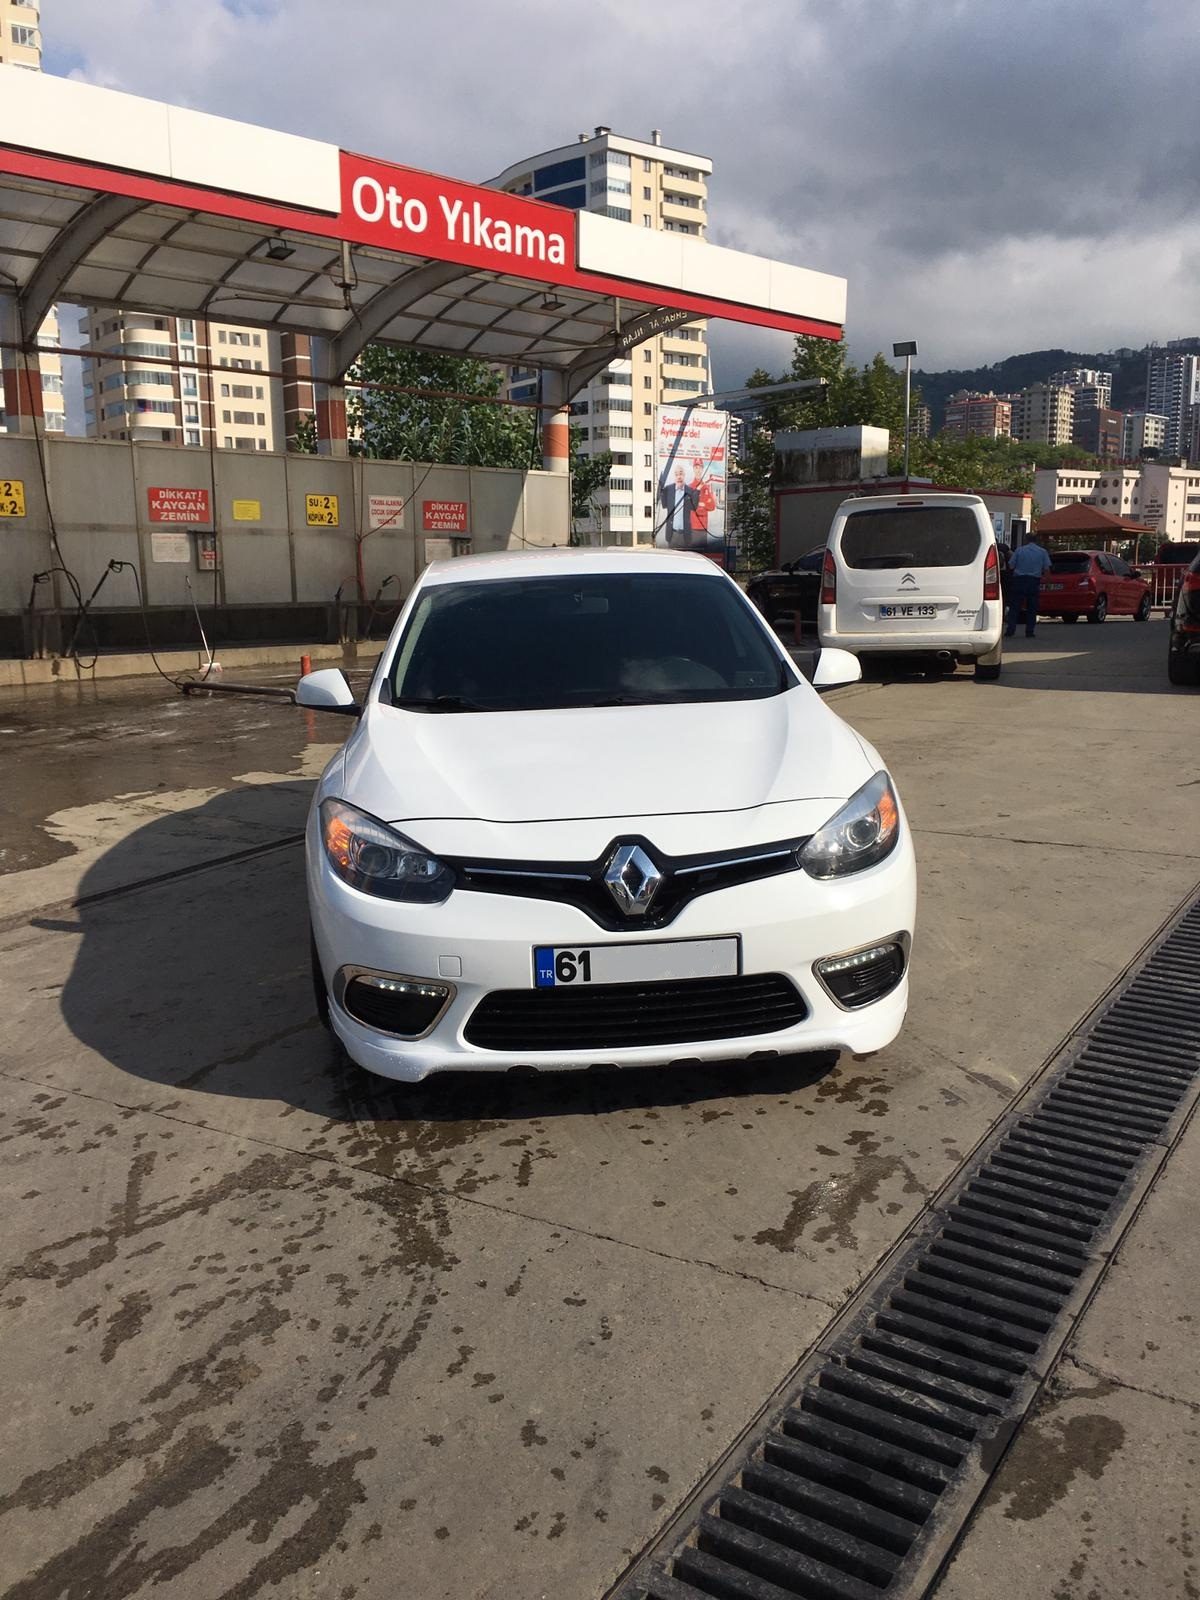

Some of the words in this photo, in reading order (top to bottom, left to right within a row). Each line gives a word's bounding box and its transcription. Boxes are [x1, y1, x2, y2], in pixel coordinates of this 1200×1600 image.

[352, 176, 428, 233] Oto
[438, 195, 565, 265] Yıkama
[4, 482, 13, 496] 2
[159, 489, 202, 501] DİKKAT!
[9, 500, 18, 515] 2
[152, 501, 206, 511] KAYGAN
[323, 497, 330, 509] 2
[160, 510, 200, 521] ZEMİN
[327, 512, 334, 524] 2
[425, 511, 465, 521] KAYGAN
[431, 520, 460, 530] ZEMİN
[886, 606, 896, 617] 61
[901, 606, 913, 616] VE
[918, 605, 935, 616] 133
[540, 969, 553, 979] TR
[555, 950, 591, 983] 61
